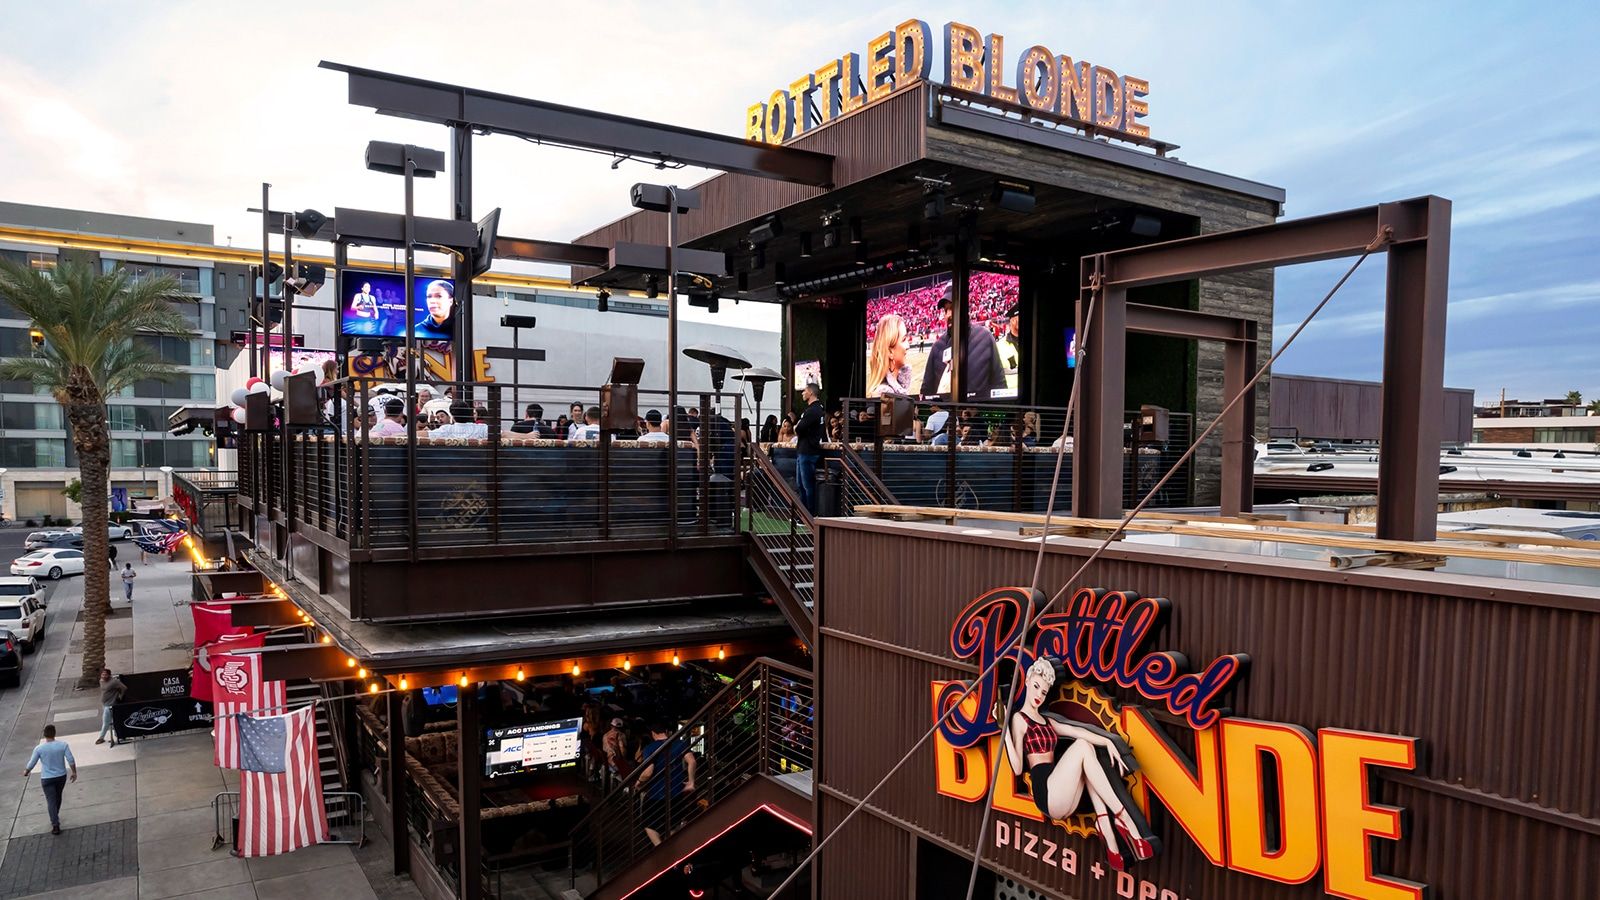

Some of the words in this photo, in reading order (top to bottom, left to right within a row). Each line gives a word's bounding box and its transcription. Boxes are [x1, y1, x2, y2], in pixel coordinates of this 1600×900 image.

[746, 18, 932, 145] BOTTLED
[944, 21, 1149, 139] BLONDE
[938, 587, 1250, 748] Bottled
[163, 677, 180, 685] CASA
[161, 685, 185, 694] AMIGOS
[523, 723, 560, 733] STANDINGS
[504, 745, 521, 753] ACC
[996, 820, 1077, 875] pizza
